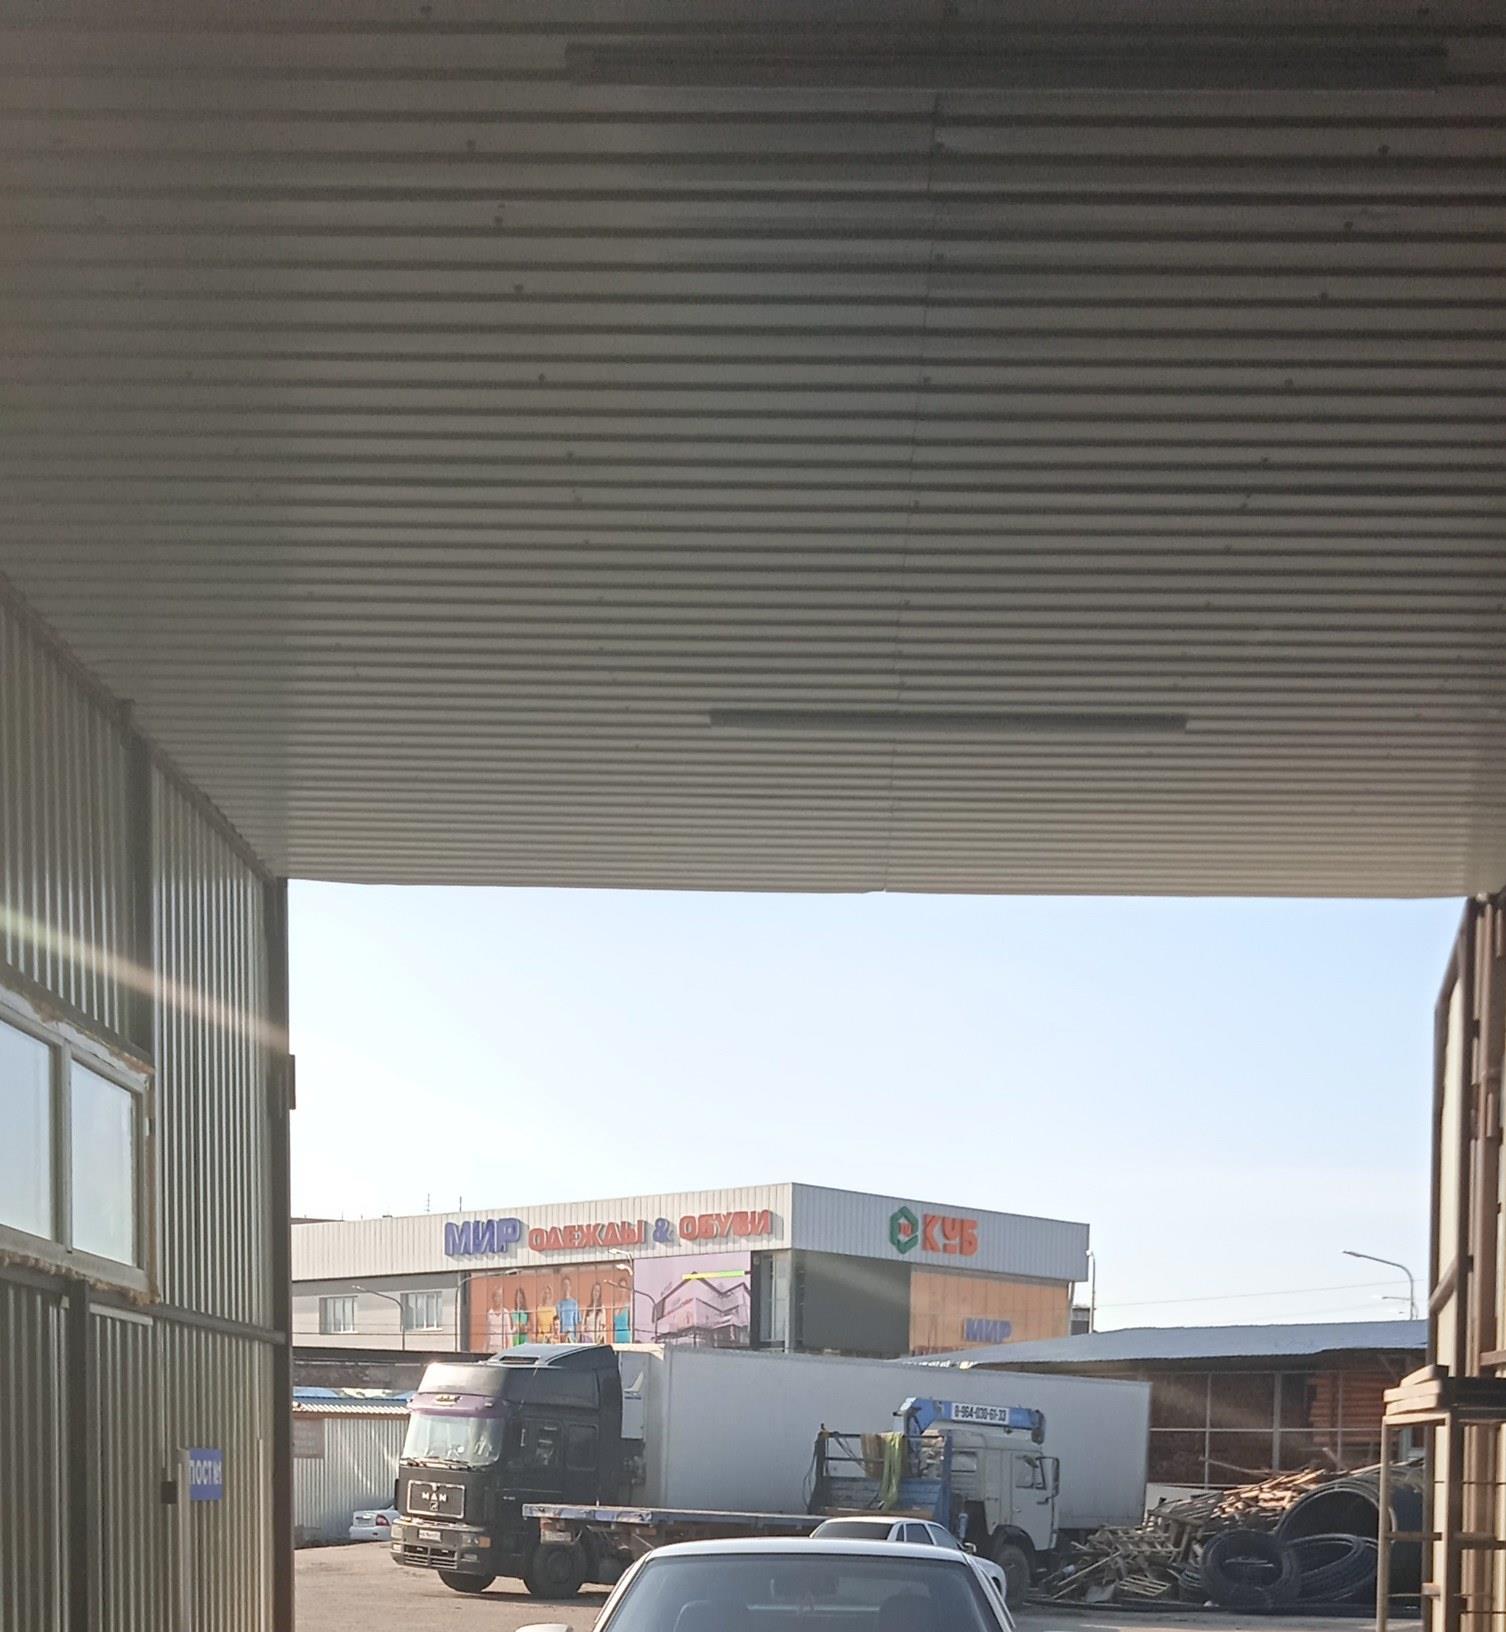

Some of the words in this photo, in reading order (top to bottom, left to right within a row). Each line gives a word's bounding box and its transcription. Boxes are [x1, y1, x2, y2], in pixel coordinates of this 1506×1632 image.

[444, 1217, 521, 1256] МИР
[528, 1219, 646, 1252] ОДЕЖДЫ
[652, 1217, 674, 1243] &
[678, 1210, 773, 1241] ОБУВИ
[922, 1213, 979, 1257] КУБ
[964, 1317, 1013, 1344] МИР
[421, 1491, 447, 1502] MAN
